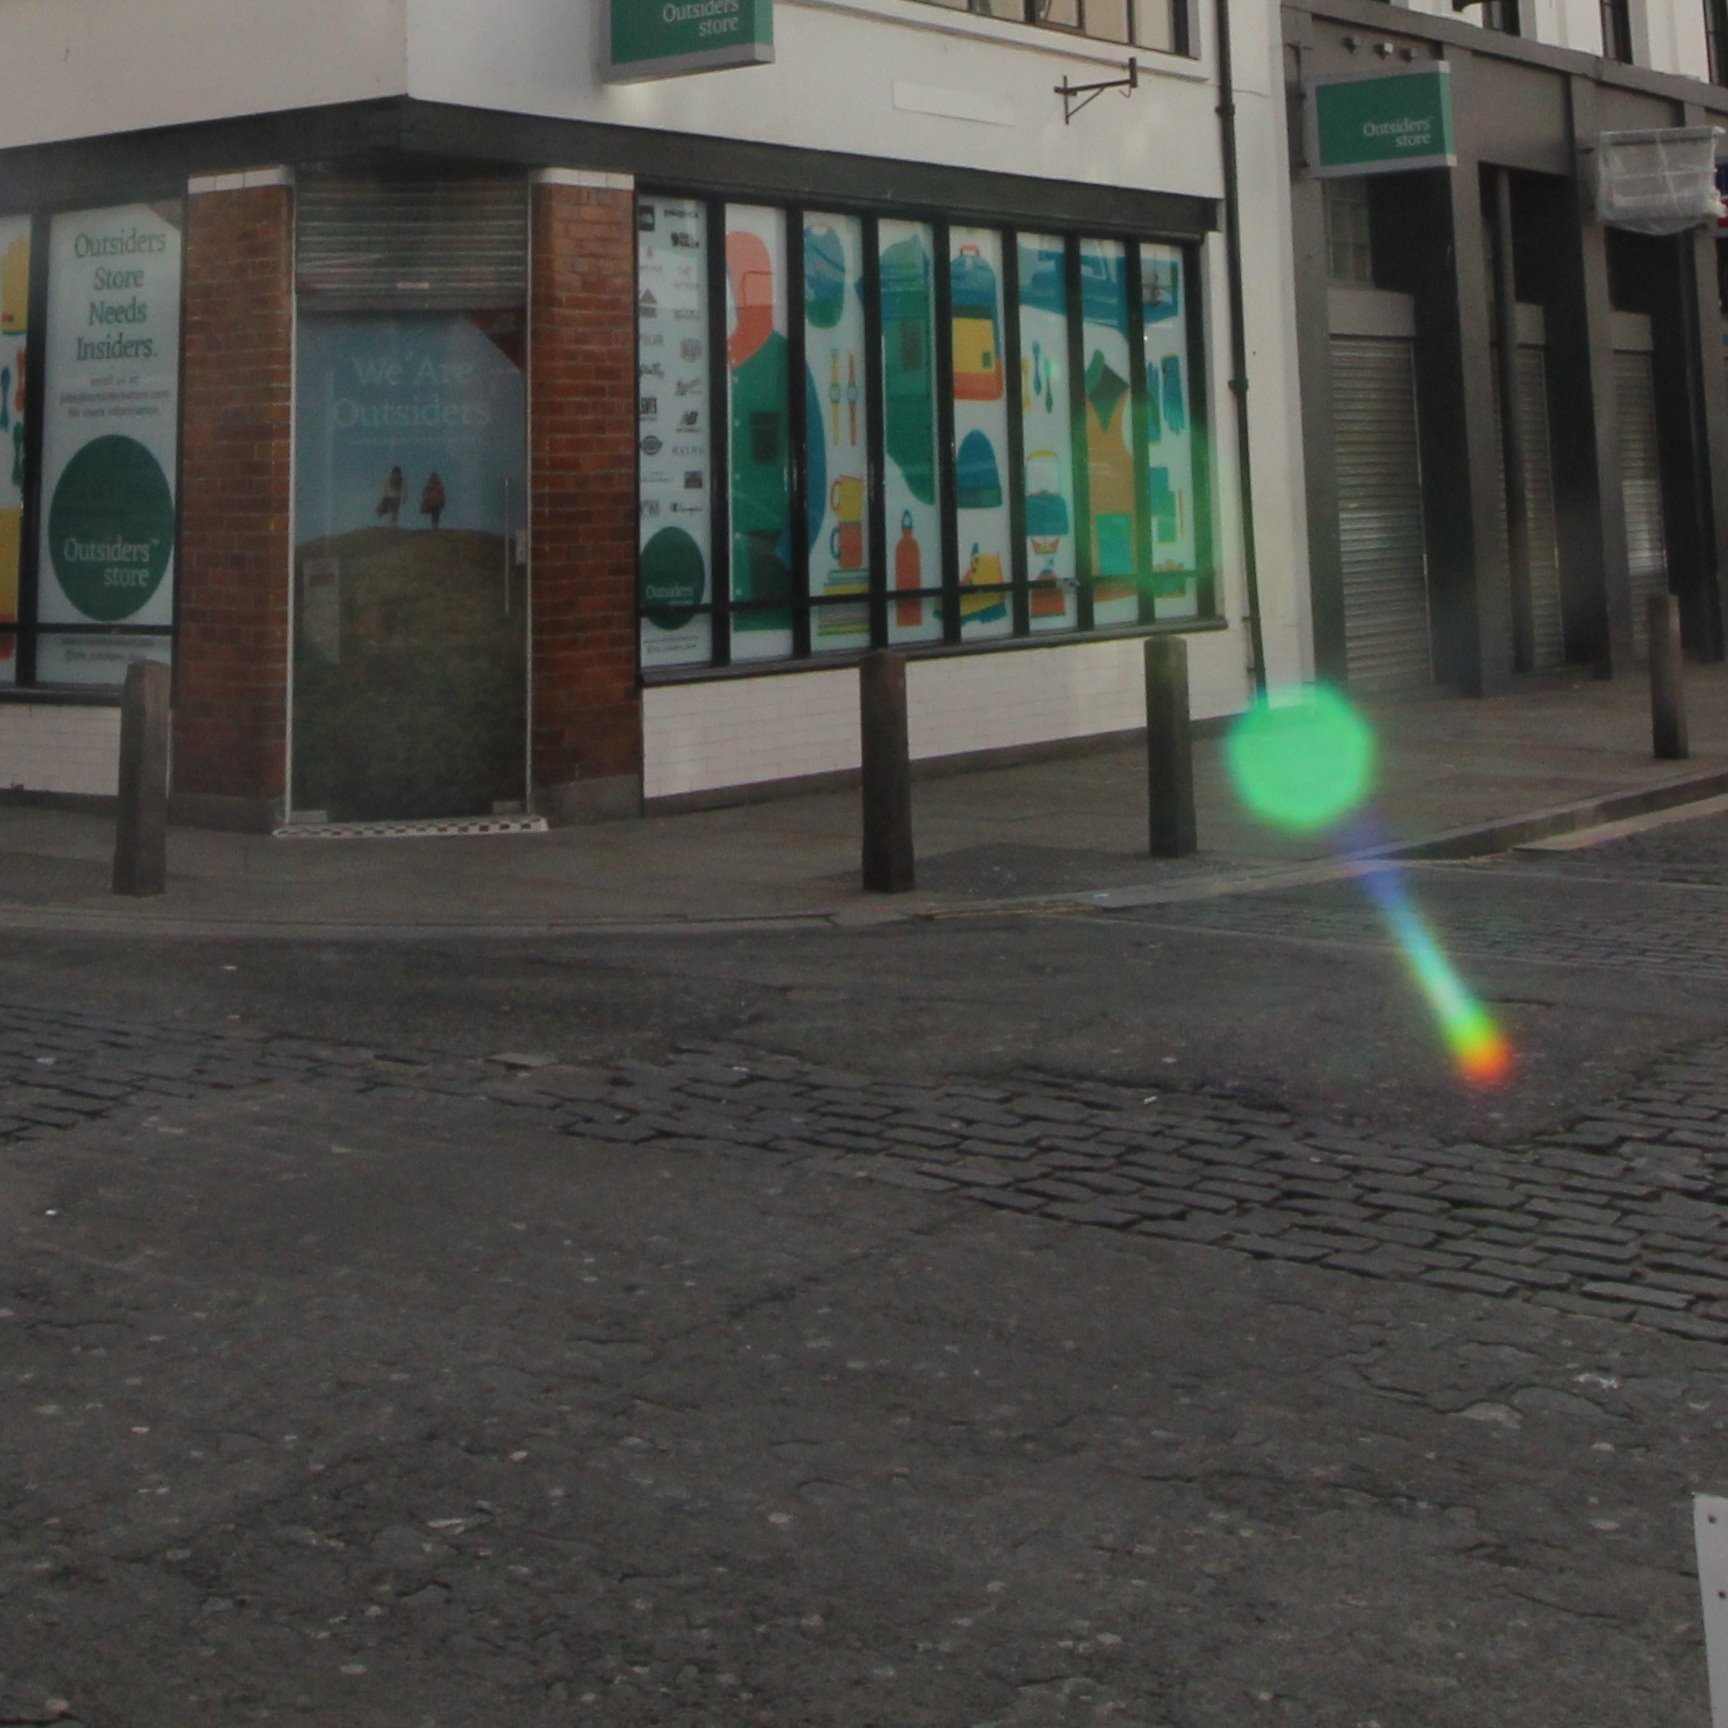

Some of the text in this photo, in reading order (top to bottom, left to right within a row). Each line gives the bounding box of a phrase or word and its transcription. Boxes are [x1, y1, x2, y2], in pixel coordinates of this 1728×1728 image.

[698, 17, 739, 37] store
[1363, 118, 1431, 138] Outsiders
[1395, 134, 1431, 147] store
[74, 228, 166, 258] Outsiders
[94, 266, 145, 291] Store
[89, 296, 147, 326] Needs
[76, 332, 158, 361] Insiders.
[351, 355, 403, 386] We
[335, 392, 494, 428] Outsiders
[63, 535, 150, 562] Outsiders
[104, 568, 149, 587] store
